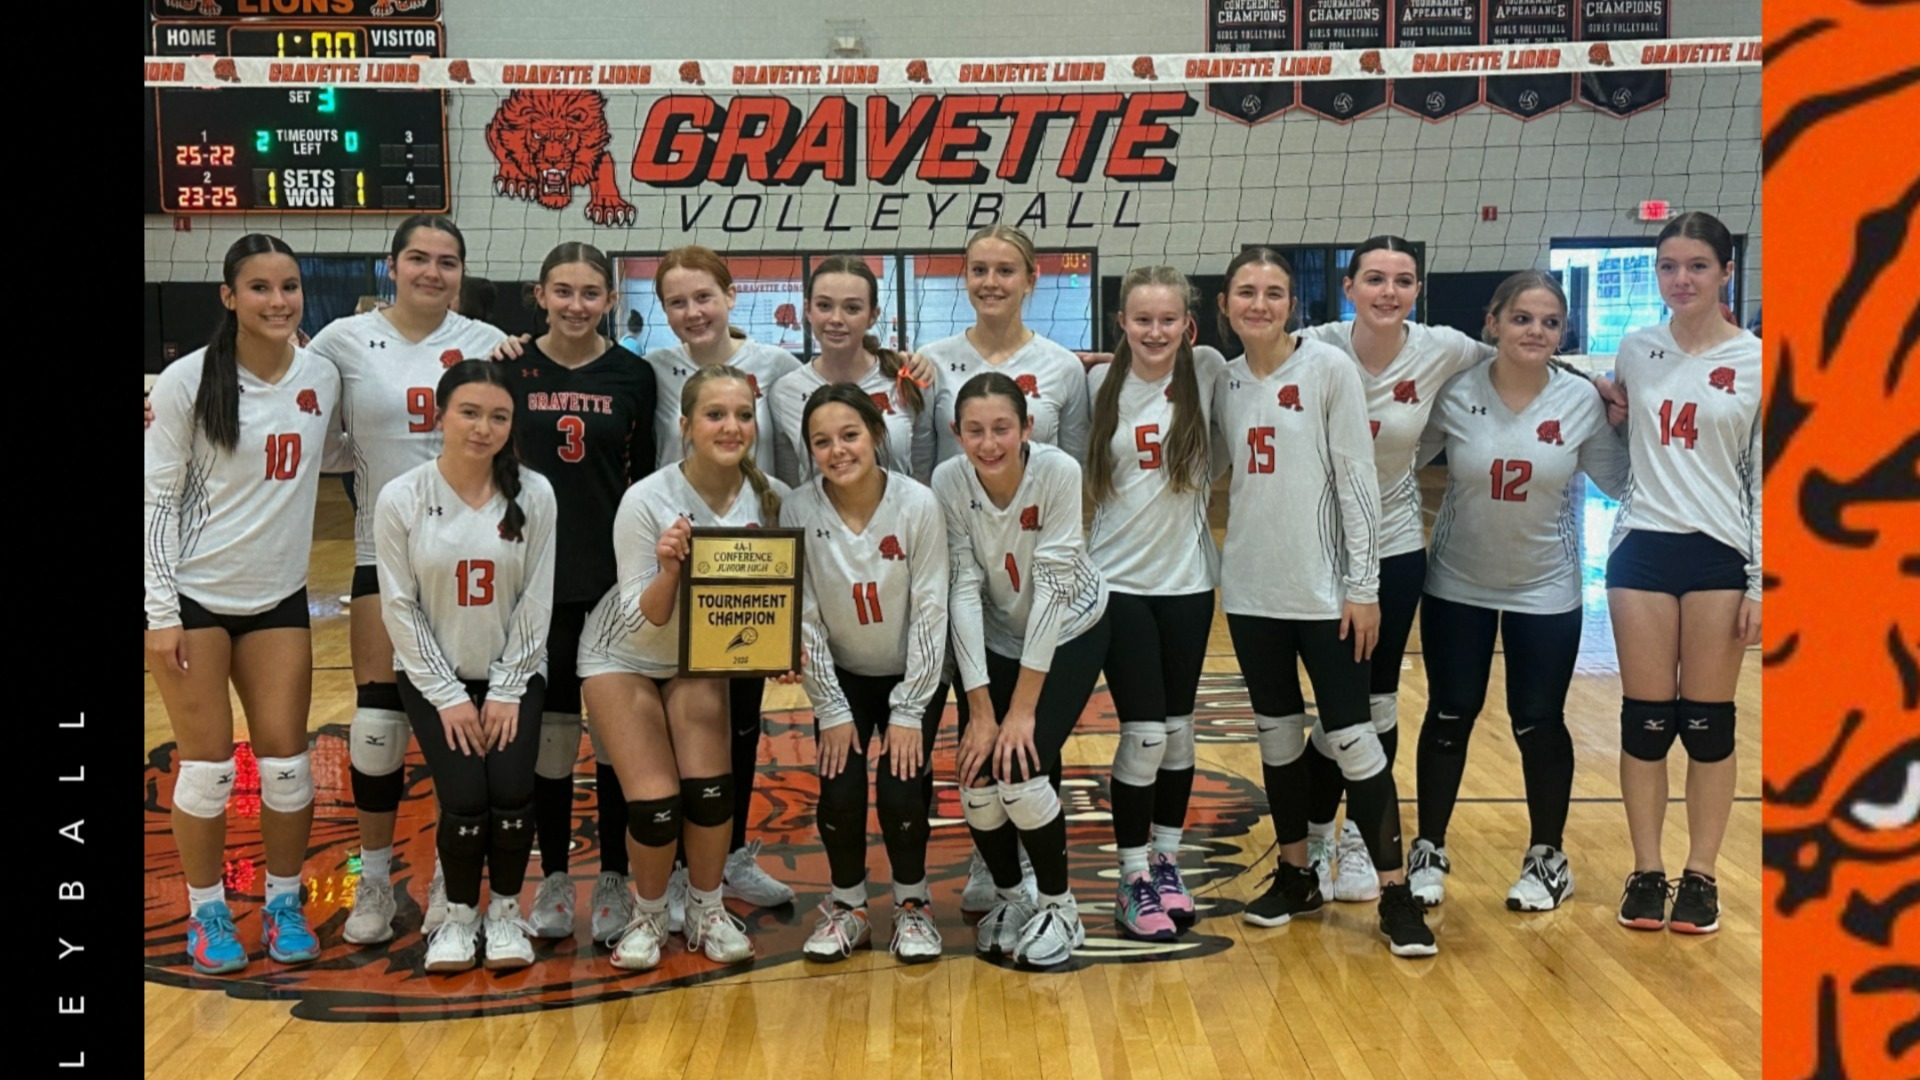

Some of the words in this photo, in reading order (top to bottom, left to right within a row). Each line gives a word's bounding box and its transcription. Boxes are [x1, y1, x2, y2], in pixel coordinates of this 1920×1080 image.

[238, 0, 355, 13] LIONS
[1224, 0, 1280, 10] CONFERENCE
[1317, 0, 1372, 8] TOURNAMENT
[1402, 6, 1472, 21] APPEARANCE
[1495, 4, 1566, 19] APPEARANCE
[1586, 0, 1662, 17] CHAMPIONS
[1218, 9, 1287, 24] CHAMPIONS
[1309, 8, 1380, 22] CHAMPIONS
[167, 29, 217, 46] HOME
[1216, 30, 1238, 40] GIRLS
[1241, 29, 1286, 39] VOLLEYBALL
[1309, 28, 1331, 38] GIRLS
[1333, 27, 1379, 38] VOLLEYBALL
[1402, 26, 1424, 37] GIRLS
[1426, 25, 1472, 36] VOLLEYBALL
[1494, 24, 1517, 35] GIRLS
[1519, 24, 1566, 34] VOLLEYBALL
[1588, 23, 1610, 33] GIRLS
[1613, 22, 1659, 33] VOLLEYBALL
[371, 29, 436, 47] VISITOR
[1412, 51, 1503, 72] GRAVETTE
[1507, 49, 1561, 69] LIONS
[1641, 43, 1733, 65] GRAVETTE
[268, 63, 360, 83] GRAVETTE
[366, 63, 420, 83] LIONS
[502, 64, 593, 84] GRAVETTE
[598, 64, 652, 84] LIONS
[732, 65, 822, 85] GRAVETTE
[826, 65, 879, 84] LIONS
[959, 62, 1049, 83] GRAVETTE
[1052, 62, 1106, 81] LIONS
[1185, 57, 1275, 79] GRAVETTE
[1279, 56, 1332, 76] LIONS
[288, 90, 311, 103] SET
[317, 85, 335, 112] 3
[201, 130, 208, 143] 1
[256, 131, 269, 152] 2
[276, 129, 338, 142] TIMEOUTS
[345, 131, 358, 152] 0
[405, 130, 413, 144] 3
[631, 90, 1199, 186] GRAVETTE
[176, 145, 235, 166] 25-22
[293, 142, 321, 155] LEFT
[203, 171, 212, 184] 2
[283, 168, 335, 188] SETS
[405, 171, 414, 185] 4
[178, 187, 238, 208] 23-25
[268, 171, 277, 206] 1
[284, 187, 335, 208] WON
[356, 171, 365, 206] 1
[679, 190, 1142, 232] VOLLEYBALL
[406, 387, 436, 433] 9
[528, 392, 613, 415] GRAVETTE
[1658, 399, 1699, 450] 14
[557, 414, 586, 463] 3
[1135, 424, 1161, 470] 5
[264, 432, 302, 481] 10
[1247, 426, 1275, 475] 15
[1489, 458, 1532, 502] 12
[713, 552, 773, 562] CONFERENCE
[733, 542, 752, 552] 4A-1
[716, 563, 746, 573] JUNIOR
[747, 563, 769, 573] HIGH
[1004, 552, 1020, 593] 1
[455, 559, 495, 607] 13
[697, 594, 787, 610] TOURNAMENT
[852, 581, 883, 625] 11
[708, 611, 775, 626] CHAMPION
